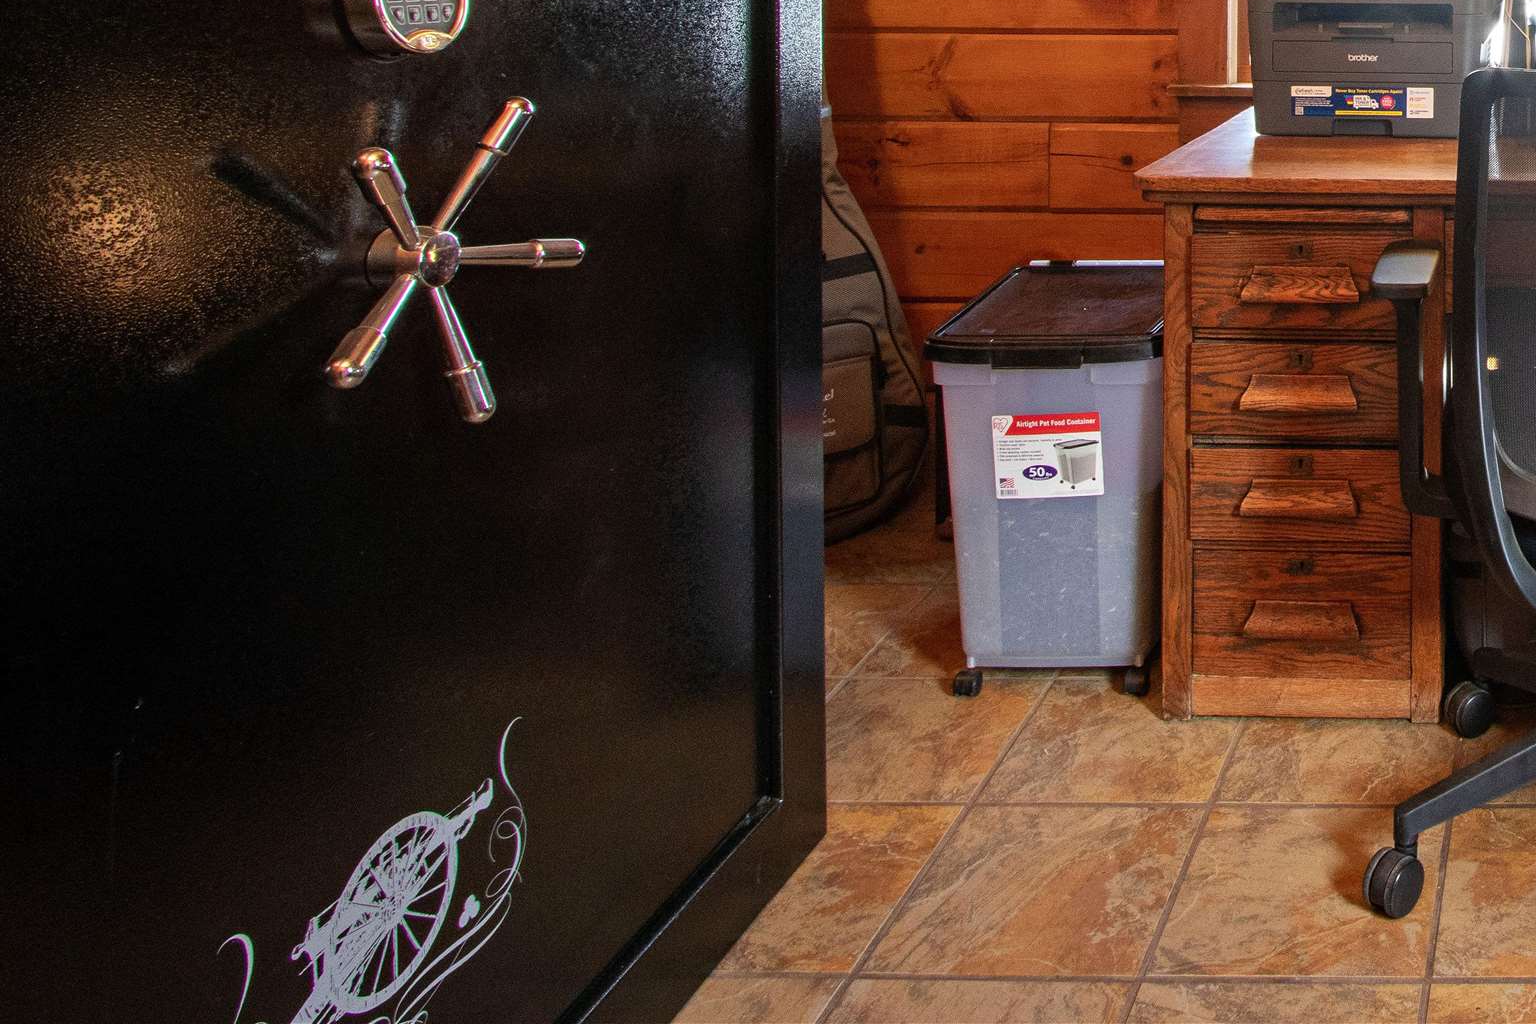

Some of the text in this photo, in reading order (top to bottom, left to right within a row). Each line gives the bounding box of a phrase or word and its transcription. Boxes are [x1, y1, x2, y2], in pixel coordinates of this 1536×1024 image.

[1347, 53, 1379, 62] brother
[1016, 419, 1038, 428] Airtight
[1039, 419, 1050, 427] Pet
[1050, 418, 1066, 426] Food
[1066, 417, 1096, 425] Container
[1029, 467, 1045, 477] 50
